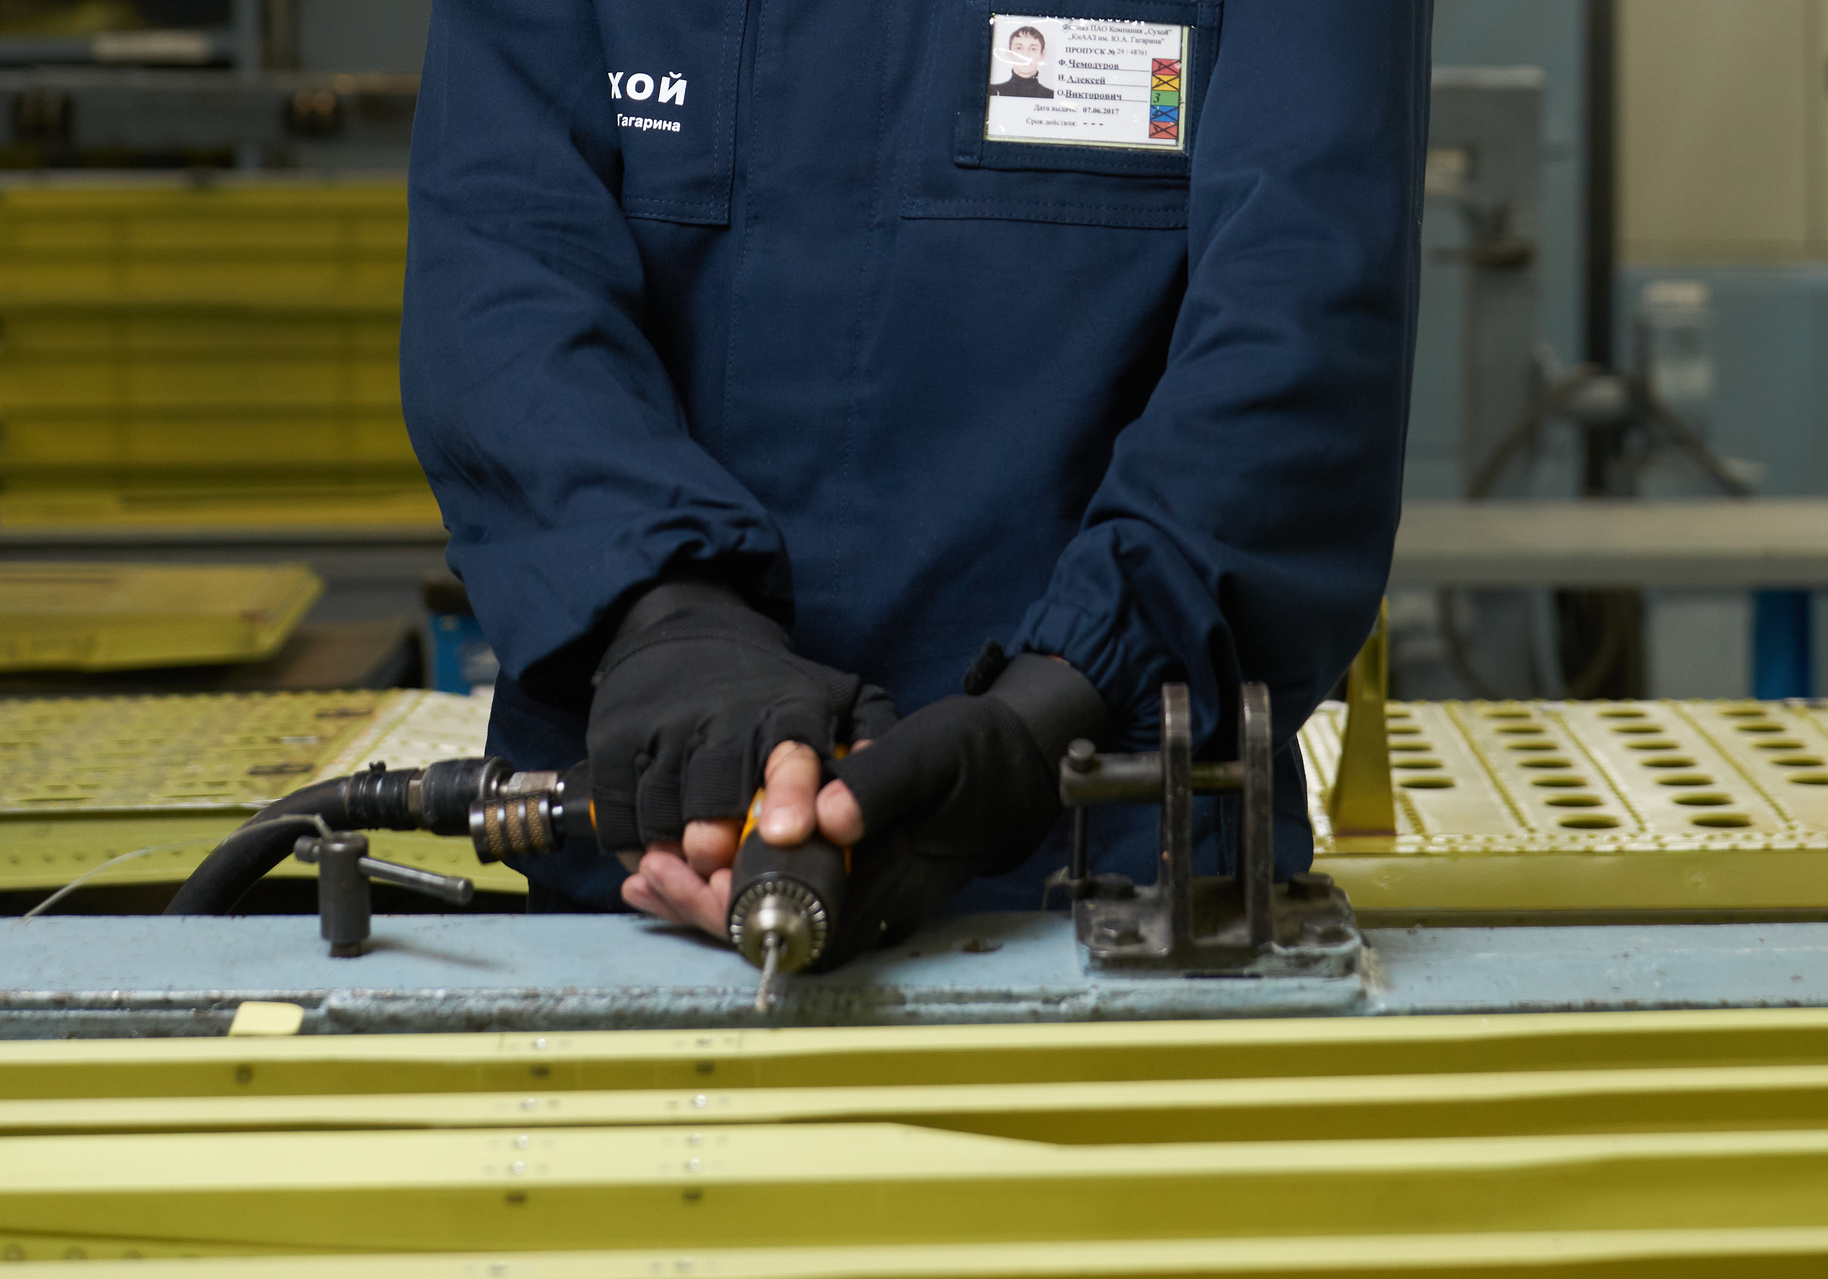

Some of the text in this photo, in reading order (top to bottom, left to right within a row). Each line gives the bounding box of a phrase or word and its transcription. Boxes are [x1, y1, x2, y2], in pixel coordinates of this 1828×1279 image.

[1090, 24, 1108, 32] ПАО
[1109, 25, 1143, 34] Компания
[1065, 46, 1106, 55] ПРОПУСК
[1066, 75, 1106, 85] Алексей
[1065, 90, 1122, 101] Викторович
[1153, 93, 1161, 104] 3
[1033, 104, 1050, 112] Дата
[1082, 107, 1119, 115] 07.06.2017
[1025, 117, 1043, 126] Срок
